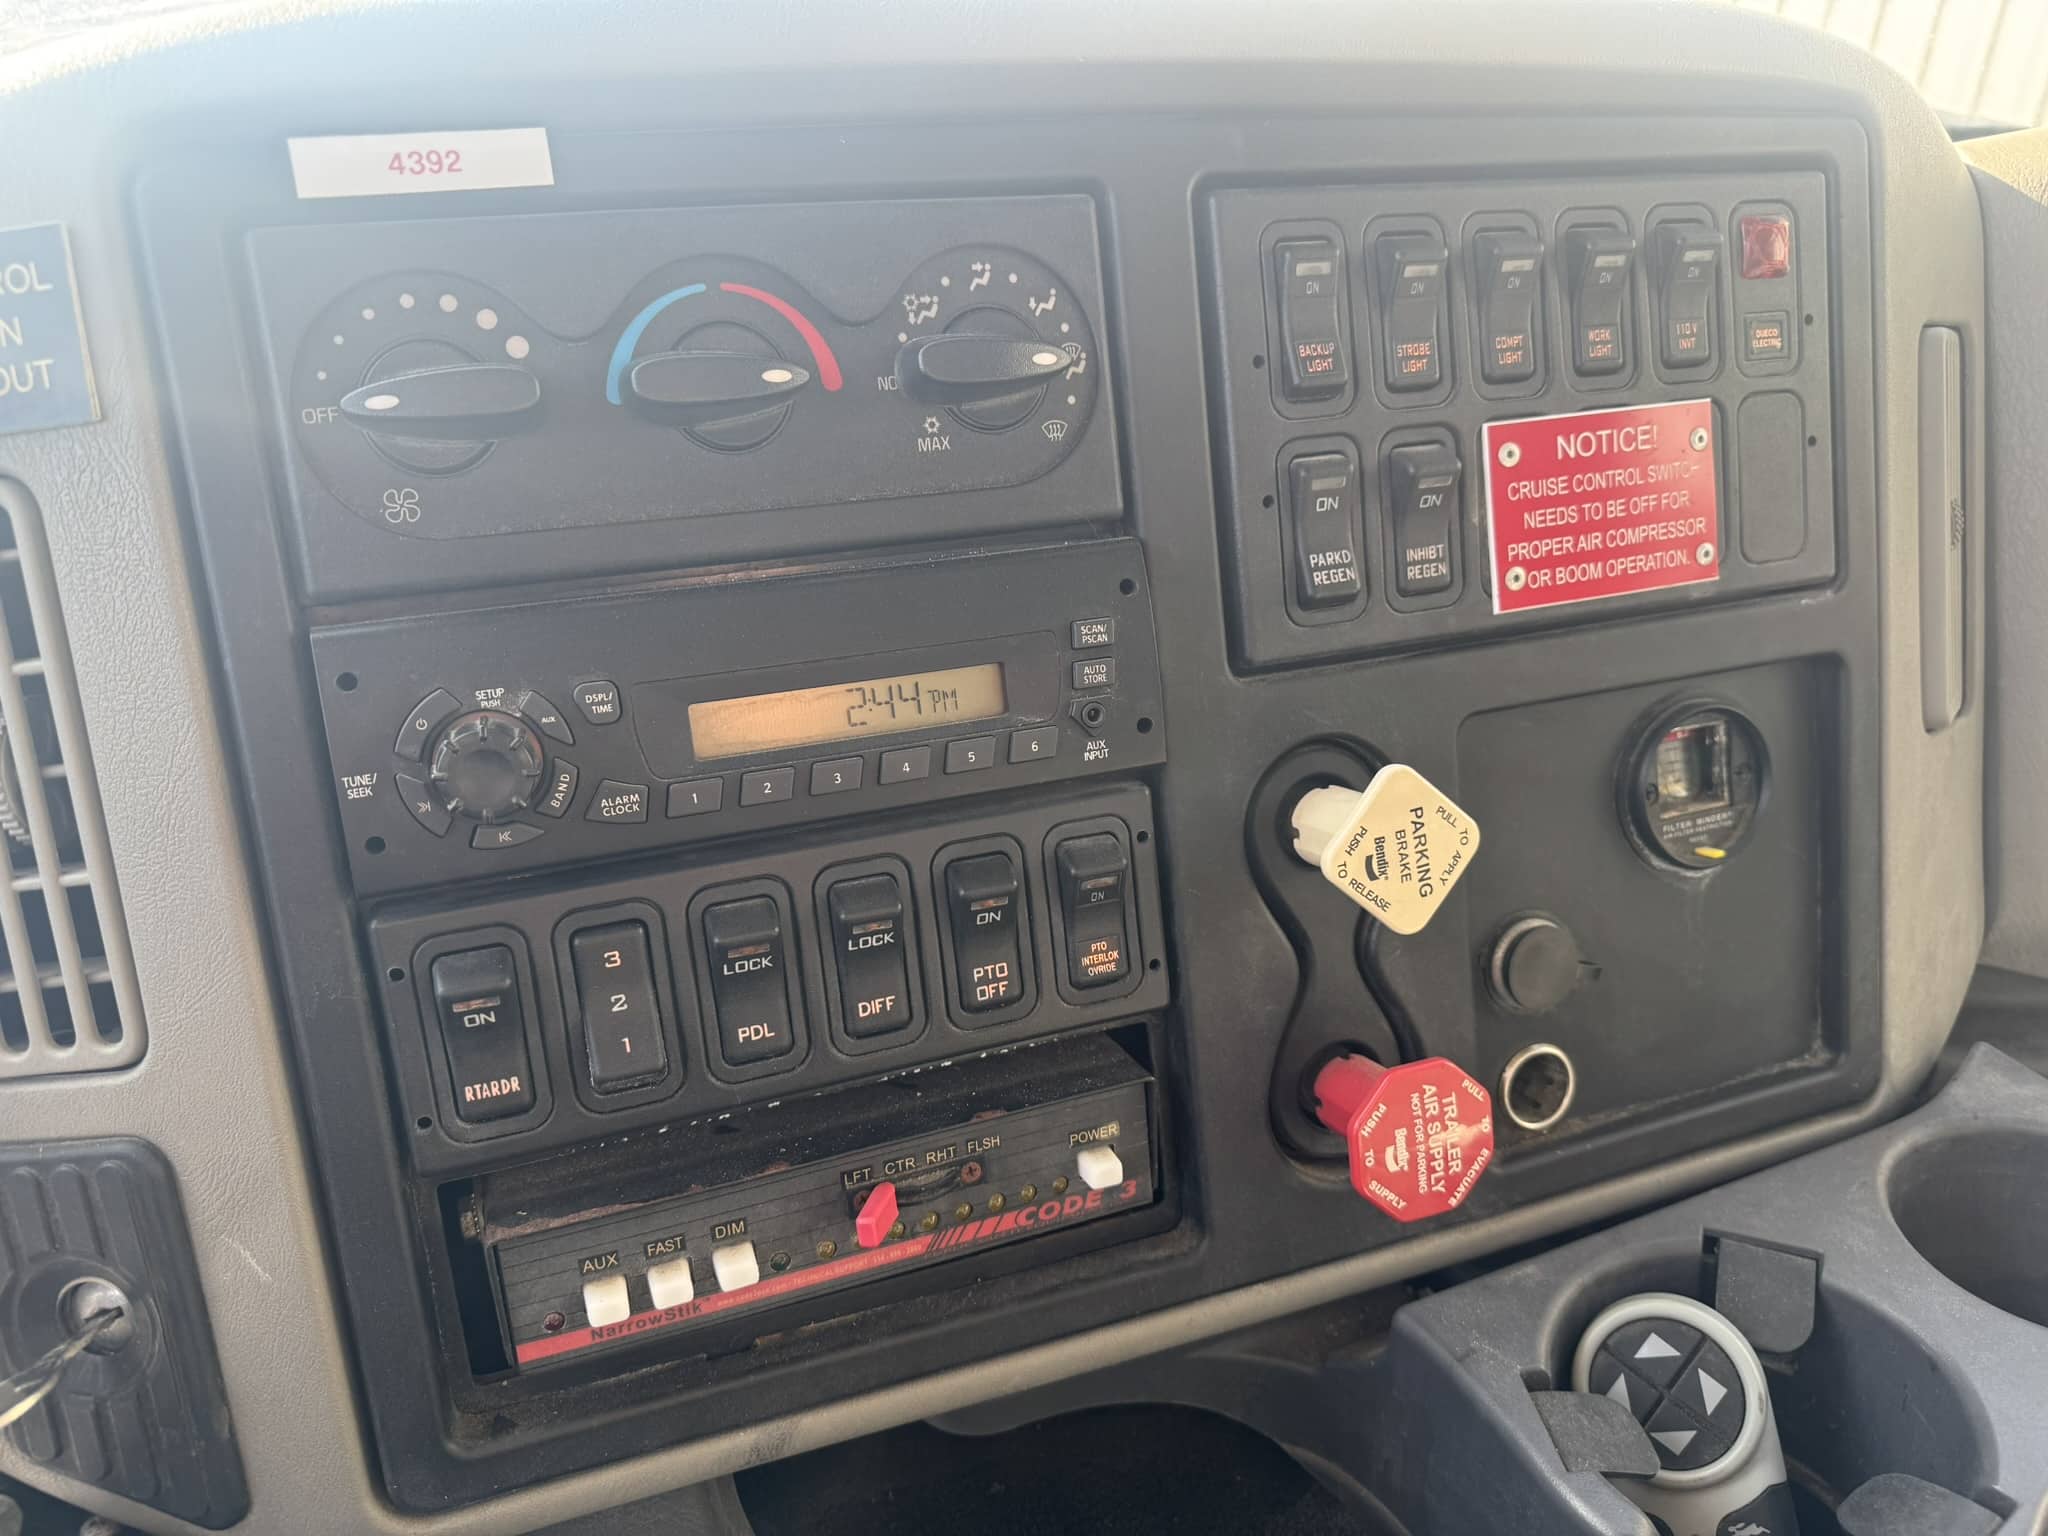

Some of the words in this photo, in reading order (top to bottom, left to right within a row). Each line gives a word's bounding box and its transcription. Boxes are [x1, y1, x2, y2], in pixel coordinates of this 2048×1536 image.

[388, 149, 463, 176] 4392
[1305, 281, 1320, 295] ON
[1410, 281, 1425, 296] ON
[1507, 276, 1521, 289] ON
[1495, 334, 1524, 349] COMPT
[1588, 327, 1612, 342] WORK
[1299, 341, 1336, 358] BACKUP
[1396, 341, 1431, 357] STROBE
[1498, 350, 1523, 365] LIGHT
[1589, 345, 1614, 359] LIGHT
[1306, 358, 1334, 374] LIGHT
[1402, 359, 1428, 374] LIGHT
[302, 406, 339, 425] OFF
[917, 435, 951, 452] MAX
[1556, 424, 1658, 461] NOTICE!
[1507, 475, 1570, 502] CRUISE
[1572, 467, 1645, 493] CONTROL
[1316, 496, 1340, 513] ON
[1419, 493, 1443, 509] ON
[1523, 506, 1578, 530] NEEDS
[1582, 502, 1602, 521] TO
[1606, 499, 1628, 519] BE
[1629, 493, 1659, 515] OFF
[1660, 489, 1691, 510] FOR
[1507, 535, 1576, 563] PROPER
[1576, 531, 1603, 553] AIR
[1605, 516, 1707, 549] COMPRESSOR
[1309, 549, 1351, 569] PARKD
[1406, 544, 1446, 563] INHIBT
[1313, 567, 1356, 586] REGEN
[1407, 562, 1447, 581] REGEN
[1527, 570, 1553, 590] OR
[1556, 560, 1602, 586] BOOM
[1605, 549, 1691, 577] OPERATION.
[1080, 623, 1109, 636] SCAN/
[1081, 632, 1109, 645] PSCAN
[1081, 664, 1108, 676] AUTO
[1082, 673, 1109, 685] STORE
[475, 687, 506, 702] SETUP
[480, 699, 501, 709] PUSH
[584, 691, 614, 704] DSPL/
[591, 703, 614, 714] TIME
[846, 681, 923, 728] 2:44
[927, 687, 960, 714] PM
[1030, 740, 1040, 753] 6
[1083, 748, 1111, 762] INPUT
[1085, 739, 1107, 752] AUX
[967, 750, 976, 763] 5
[902, 761, 911, 774] 4
[341, 772, 377, 788] TUNE/
[833, 772, 843, 785] 3
[346, 786, 374, 800] SEEK
[550, 772, 570, 808] BAND
[691, 792, 699, 804] 1
[763, 782, 773, 795] 2
[600, 792, 641, 808] ALARM
[602, 803, 641, 817] CLOCK
[1435, 805, 1457, 829] PULL
[1344, 825, 1368, 857] PUSH
[1459, 827, 1469, 846] TO
[1395, 829, 1412, 884] BRAKE
[1409, 806, 1434, 898] PARKING
[1337, 860, 1348, 880] TO
[1439, 850, 1462, 886] APPLY
[1090, 890, 1105, 902] ON
[1348, 879, 1392, 913] RELEASE
[976, 909, 1002, 926] ON
[848, 930, 895, 952] LOCK
[1090, 941, 1108, 953] PTO
[604, 950, 622, 969] 3
[723, 955, 774, 976] LOCK
[1081, 949, 1120, 967] INTERLOK
[973, 961, 1009, 983] PTO
[1087, 961, 1118, 977] OVRIDE
[976, 980, 1009, 1001] OFF
[610, 993, 629, 1012] 2
[858, 995, 896, 1019] DIFF
[463, 1010, 497, 1029] ON
[737, 1023, 775, 1044] PDL
[621, 1037, 632, 1054] 1
[464, 1075, 522, 1103] RTARDR
[1462, 1079, 1486, 1102] PULL
[1410, 1092, 1422, 1117] NOT
[1422, 1084, 1440, 1119] AIR
[1360, 1102, 1388, 1138] PUSH
[1480, 1114, 1491, 1133] TO
[1069, 1123, 1120, 1147] POWER
[1413, 1118, 1425, 1143] FOR
[1442, 1091, 1463, 1176] TRAILER
[843, 1167, 872, 1187] LFT
[884, 1155, 917, 1177] CTR
[925, 1146, 957, 1166] RHT
[967, 1135, 1001, 1155] FLSH
[1363, 1148, 1375, 1168] TO
[1427, 1121, 1447, 1194] SUPPLY
[1416, 1143, 1428, 1194] PARKING
[1448, 1148, 1490, 1208] EVACUATE
[1014, 1190, 1102, 1227] CODE
[1118, 1179, 1138, 1200] 3
[1368, 1180, 1408, 1210] SUPPLY
[714, 1220, 746, 1241] DIM
[647, 1235, 684, 1258] FAST
[582, 1252, 619, 1273] AUX
[591, 1301, 704, 1342] NarrowStik
